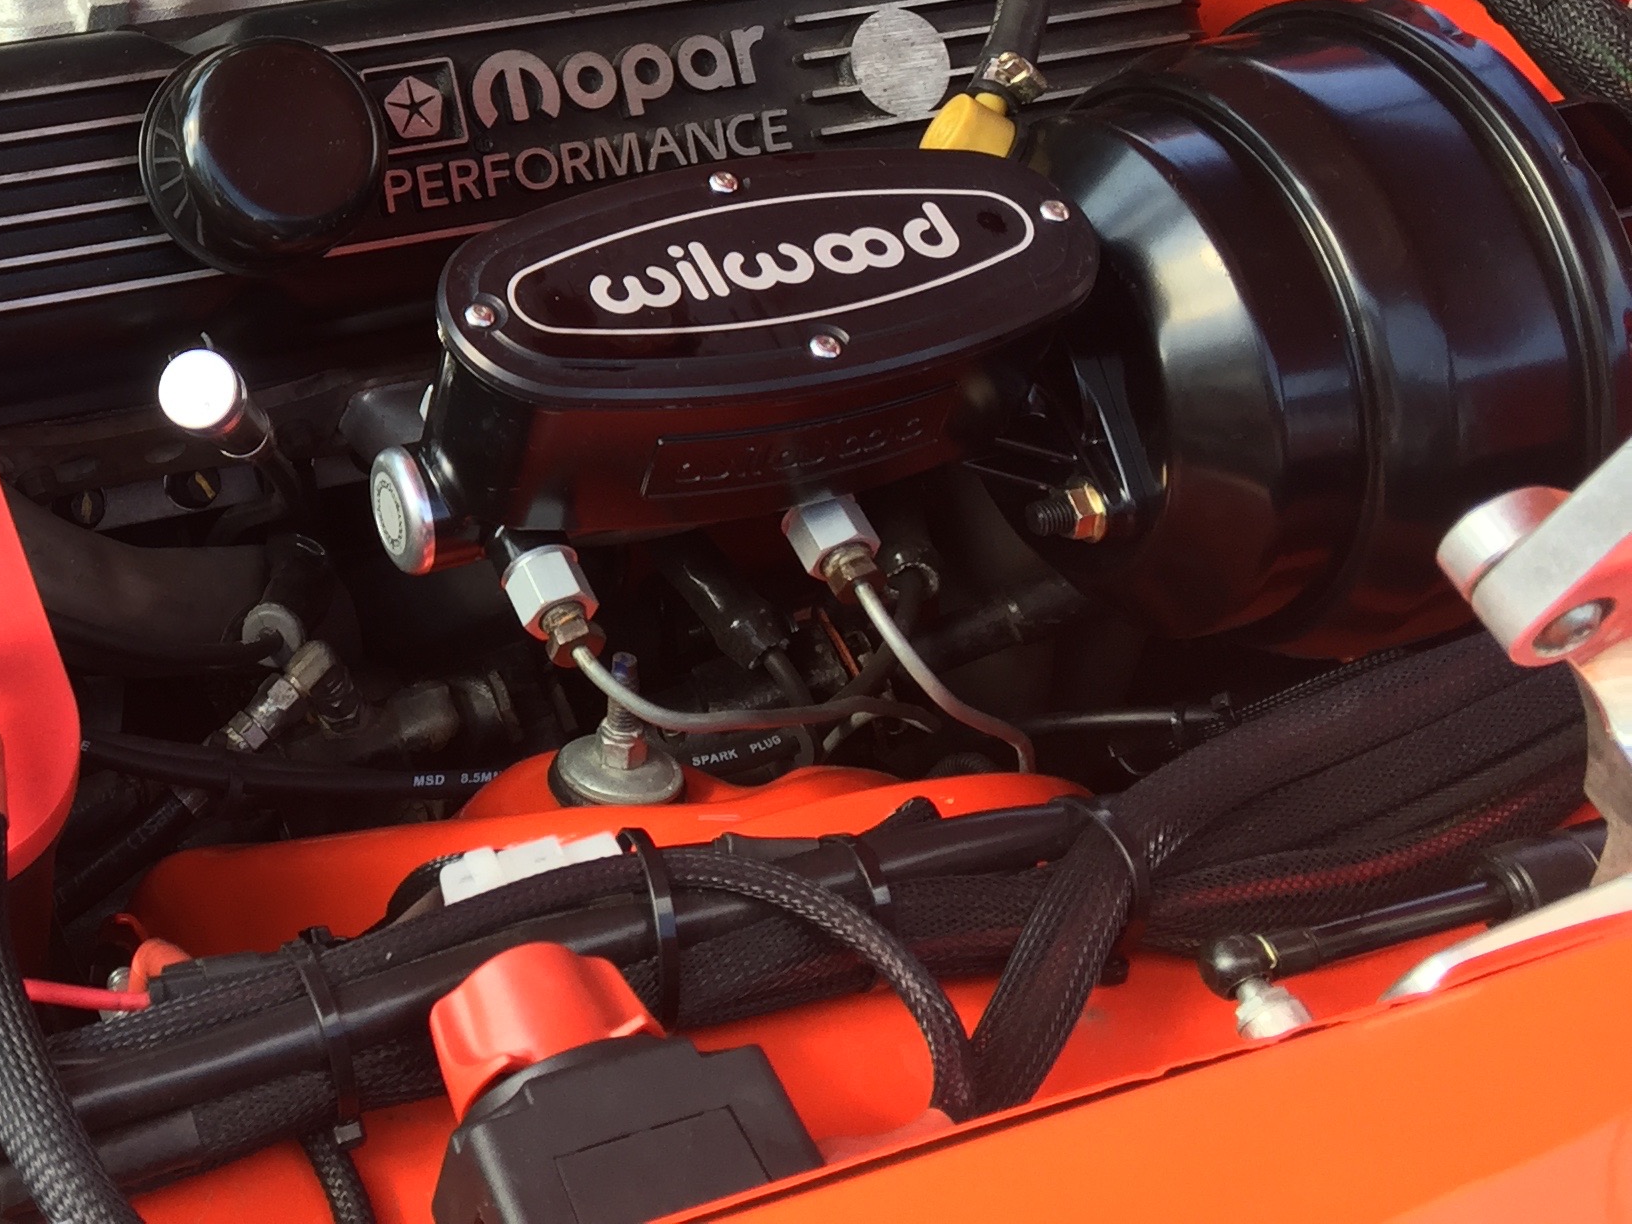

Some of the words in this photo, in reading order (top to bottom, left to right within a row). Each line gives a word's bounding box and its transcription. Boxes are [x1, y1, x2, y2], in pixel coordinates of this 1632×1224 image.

[384, 108, 793, 214] PERFORMANCE
[589, 201, 960, 315] wilwood
[413, 774, 446, 787] MSD
[691, 748, 739, 767] SPARK
[749, 734, 782, 754] PLUG
